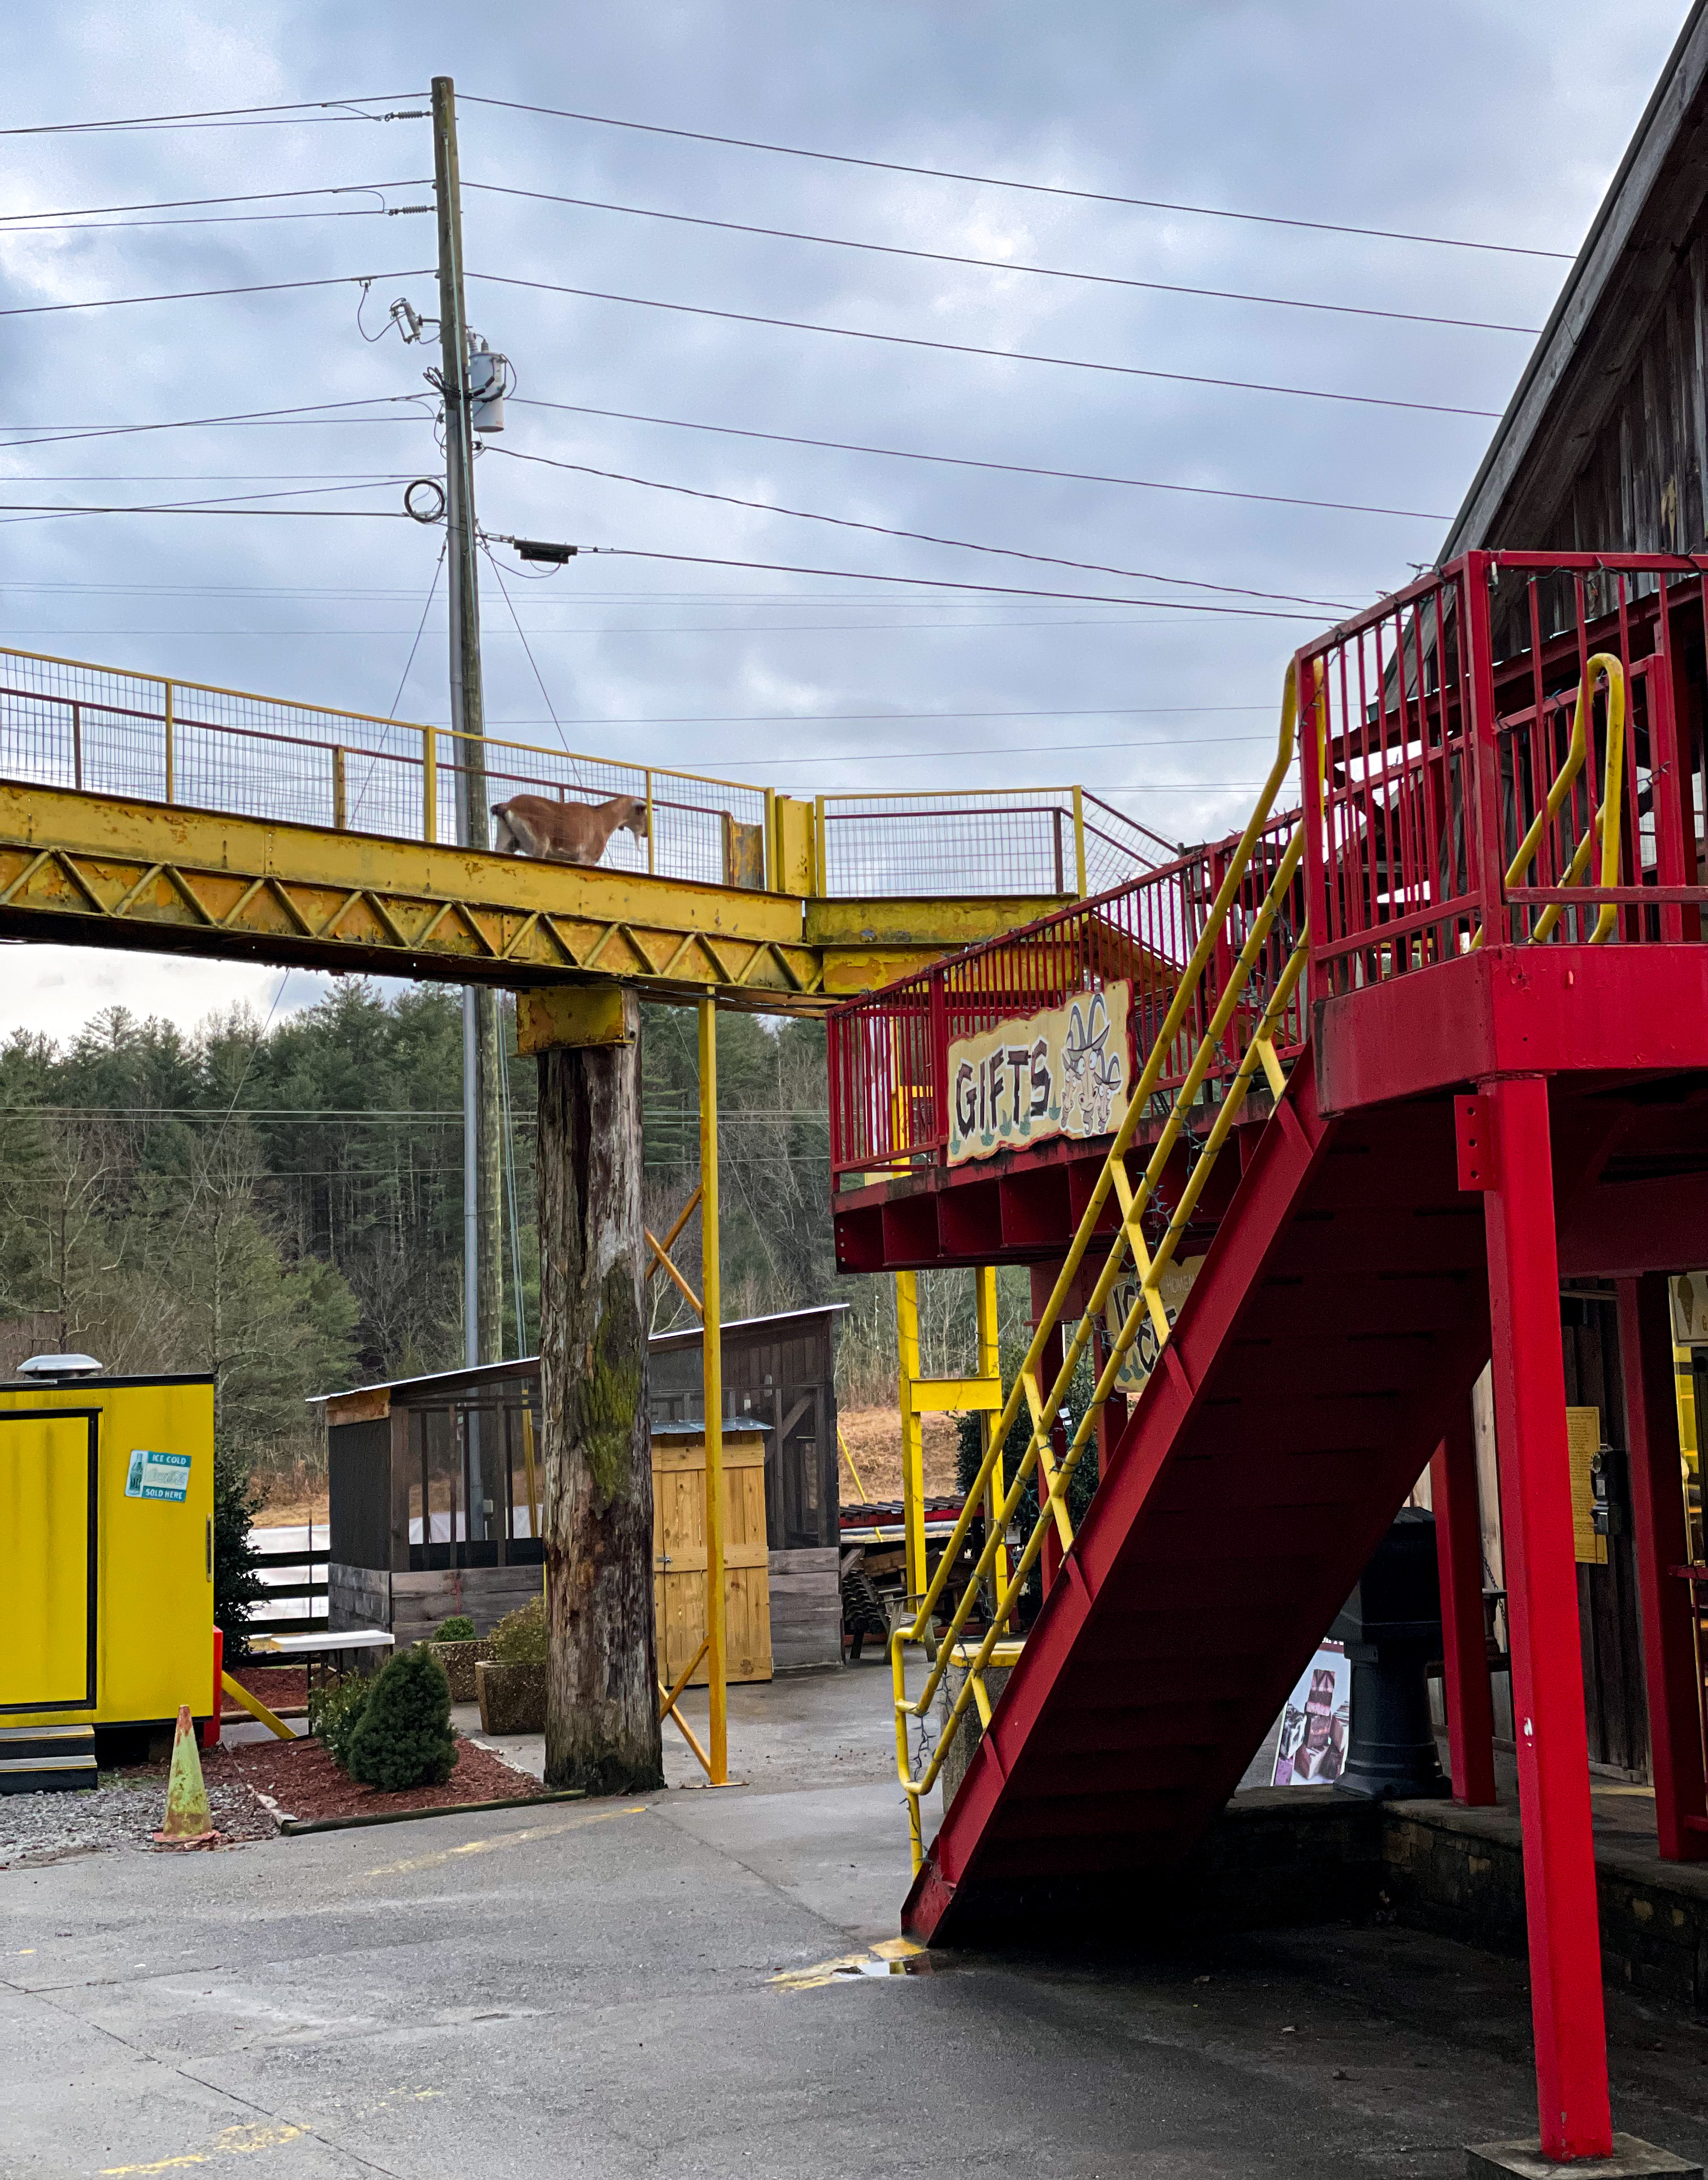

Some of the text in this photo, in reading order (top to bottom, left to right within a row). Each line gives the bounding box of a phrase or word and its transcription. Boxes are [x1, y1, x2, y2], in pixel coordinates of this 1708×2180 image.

[956, 1038, 1052, 1139] GIFTS
[152, 1454, 186, 1465] ICE COLD
[145, 1488, 183, 1499] SOLD HERE
